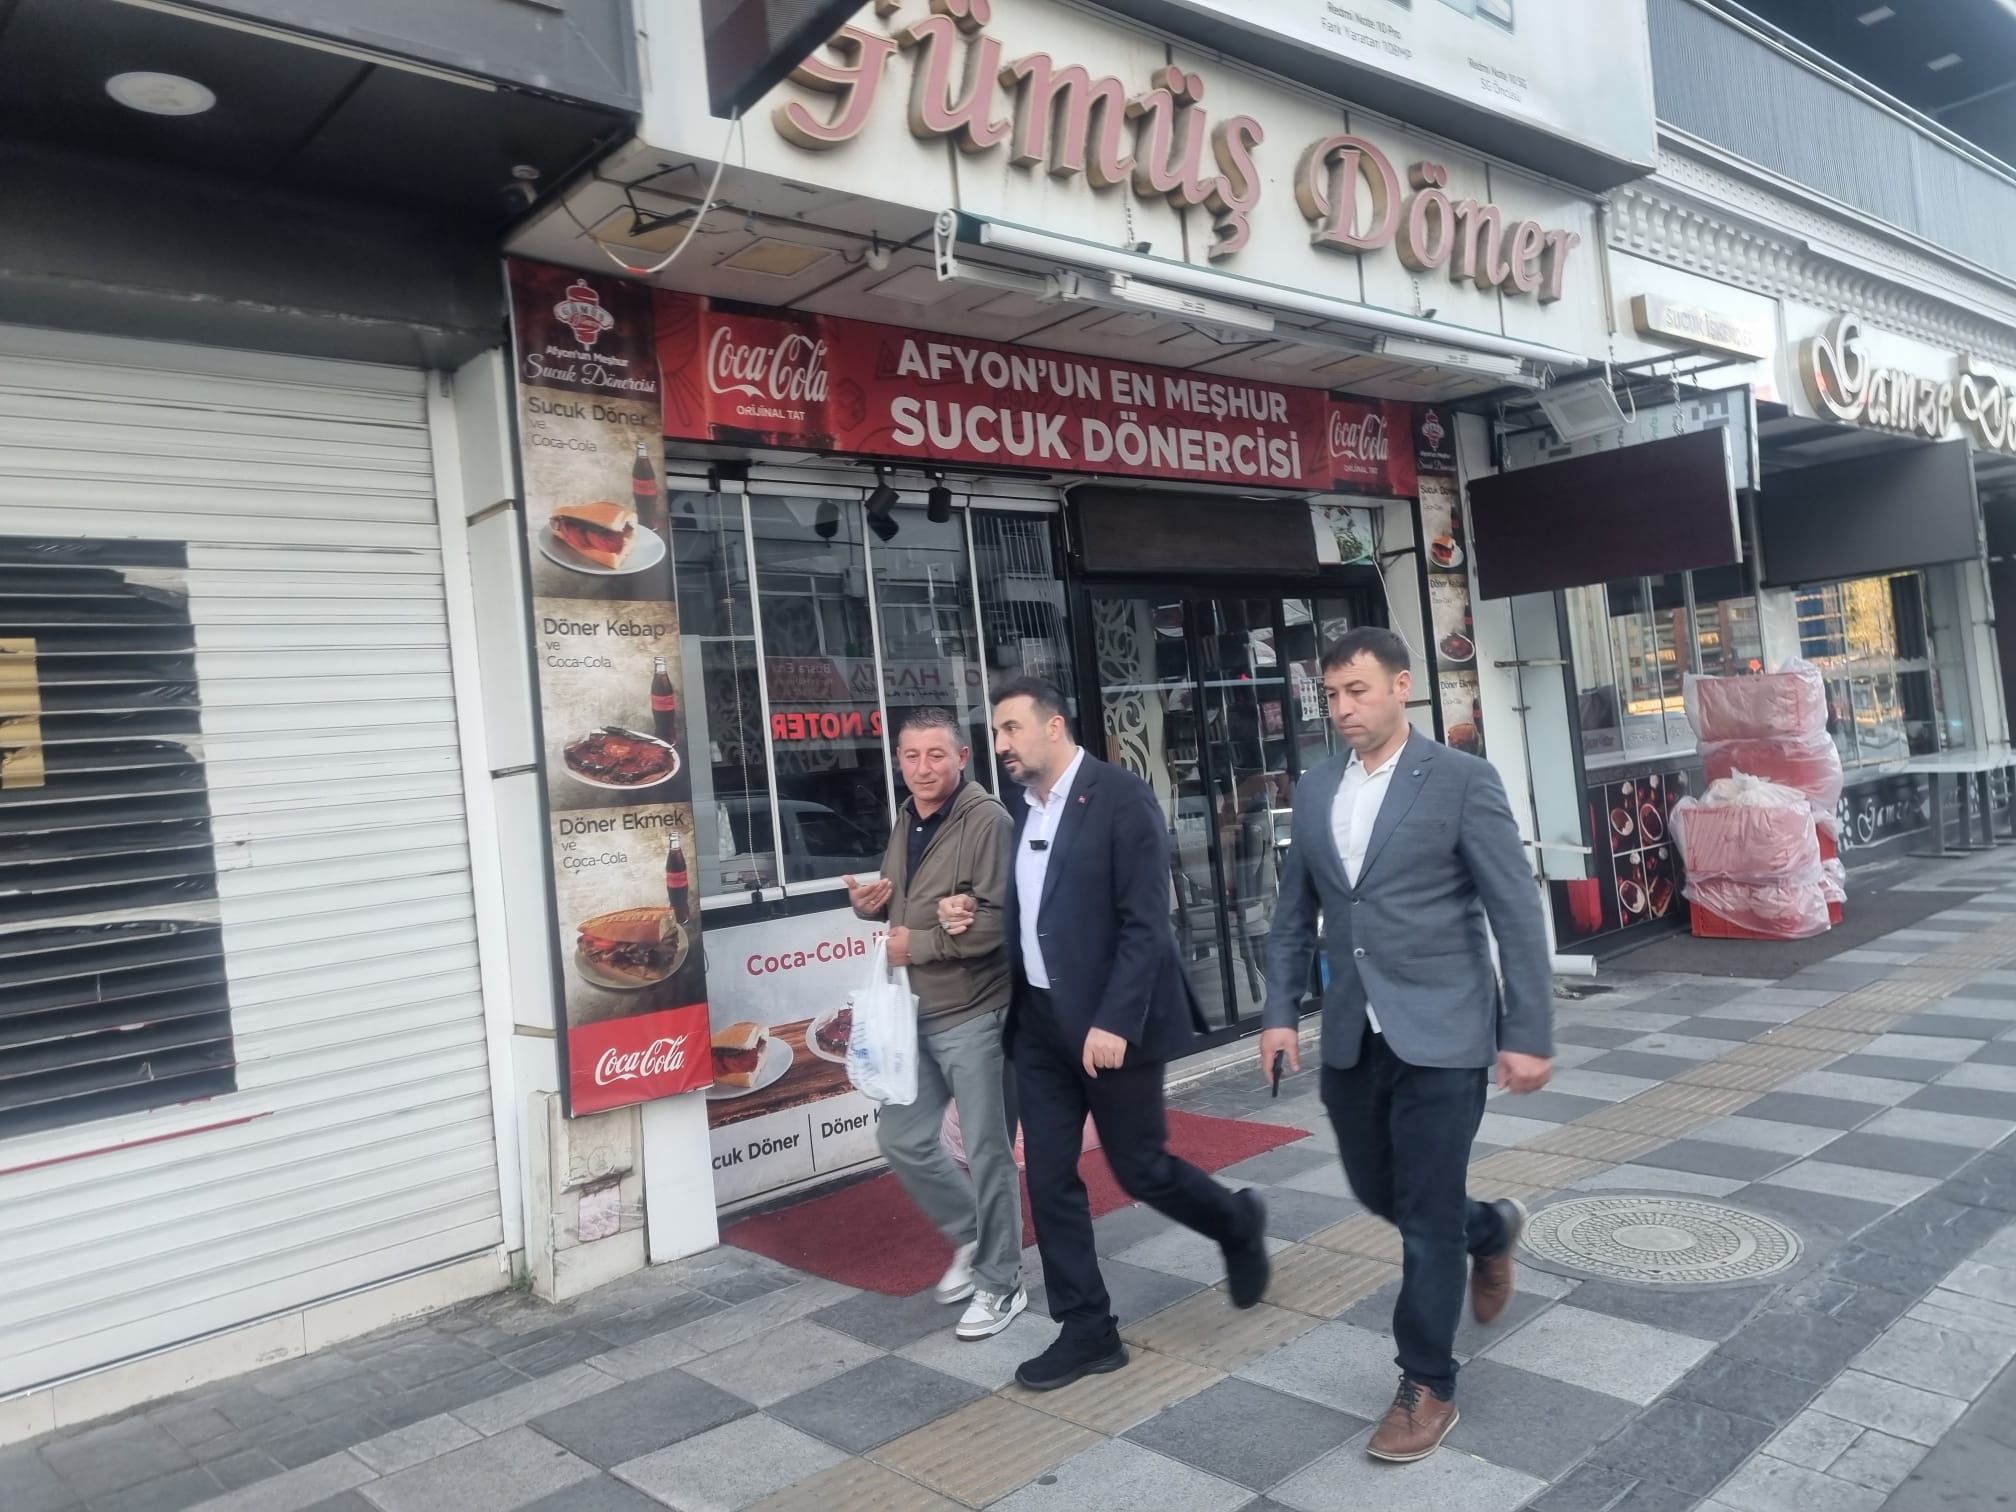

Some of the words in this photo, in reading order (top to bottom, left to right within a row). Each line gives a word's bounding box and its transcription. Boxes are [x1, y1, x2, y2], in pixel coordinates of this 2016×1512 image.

[1295, 135, 1581, 303] Döner
[524, 353, 577, 382] Sucuk
[581, 363, 657, 393] Dönercisi
[708, 325, 829, 402] Coca-Cola
[897, 338, 1101, 399] AFYON'UN
[1110, 369, 1158, 410] EN
[1165, 377, 1290, 424] MEŞHUR
[528, 396, 586, 420] Sucuk
[592, 404, 649, 426] Döner
[786, 410, 806, 421] TAT
[531, 433, 598, 453] Coca-Cola
[891, 396, 1074, 460] SUCUK
[1081, 410, 1303, 480] DÖNERCİSİ
[1328, 409, 1389, 461] Coca-Cola
[543, 618, 600, 636] Döner
[606, 619, 666, 641] Kebap
[545, 641, 561, 651] ve
[547, 655, 612, 668] Coca-Cola
[560, 816, 617, 836] Döner
[622, 810, 685, 831] Ekmek
[561, 841, 577, 852] ve
[563, 851, 628, 869] Coca-Cola
[746, 936, 866, 976] Coca-Cola
[594, 1033, 689, 1086] Coca-Cola
[820, 1113, 869, 1138] Döner
[748, 1133, 800, 1160] Döner
